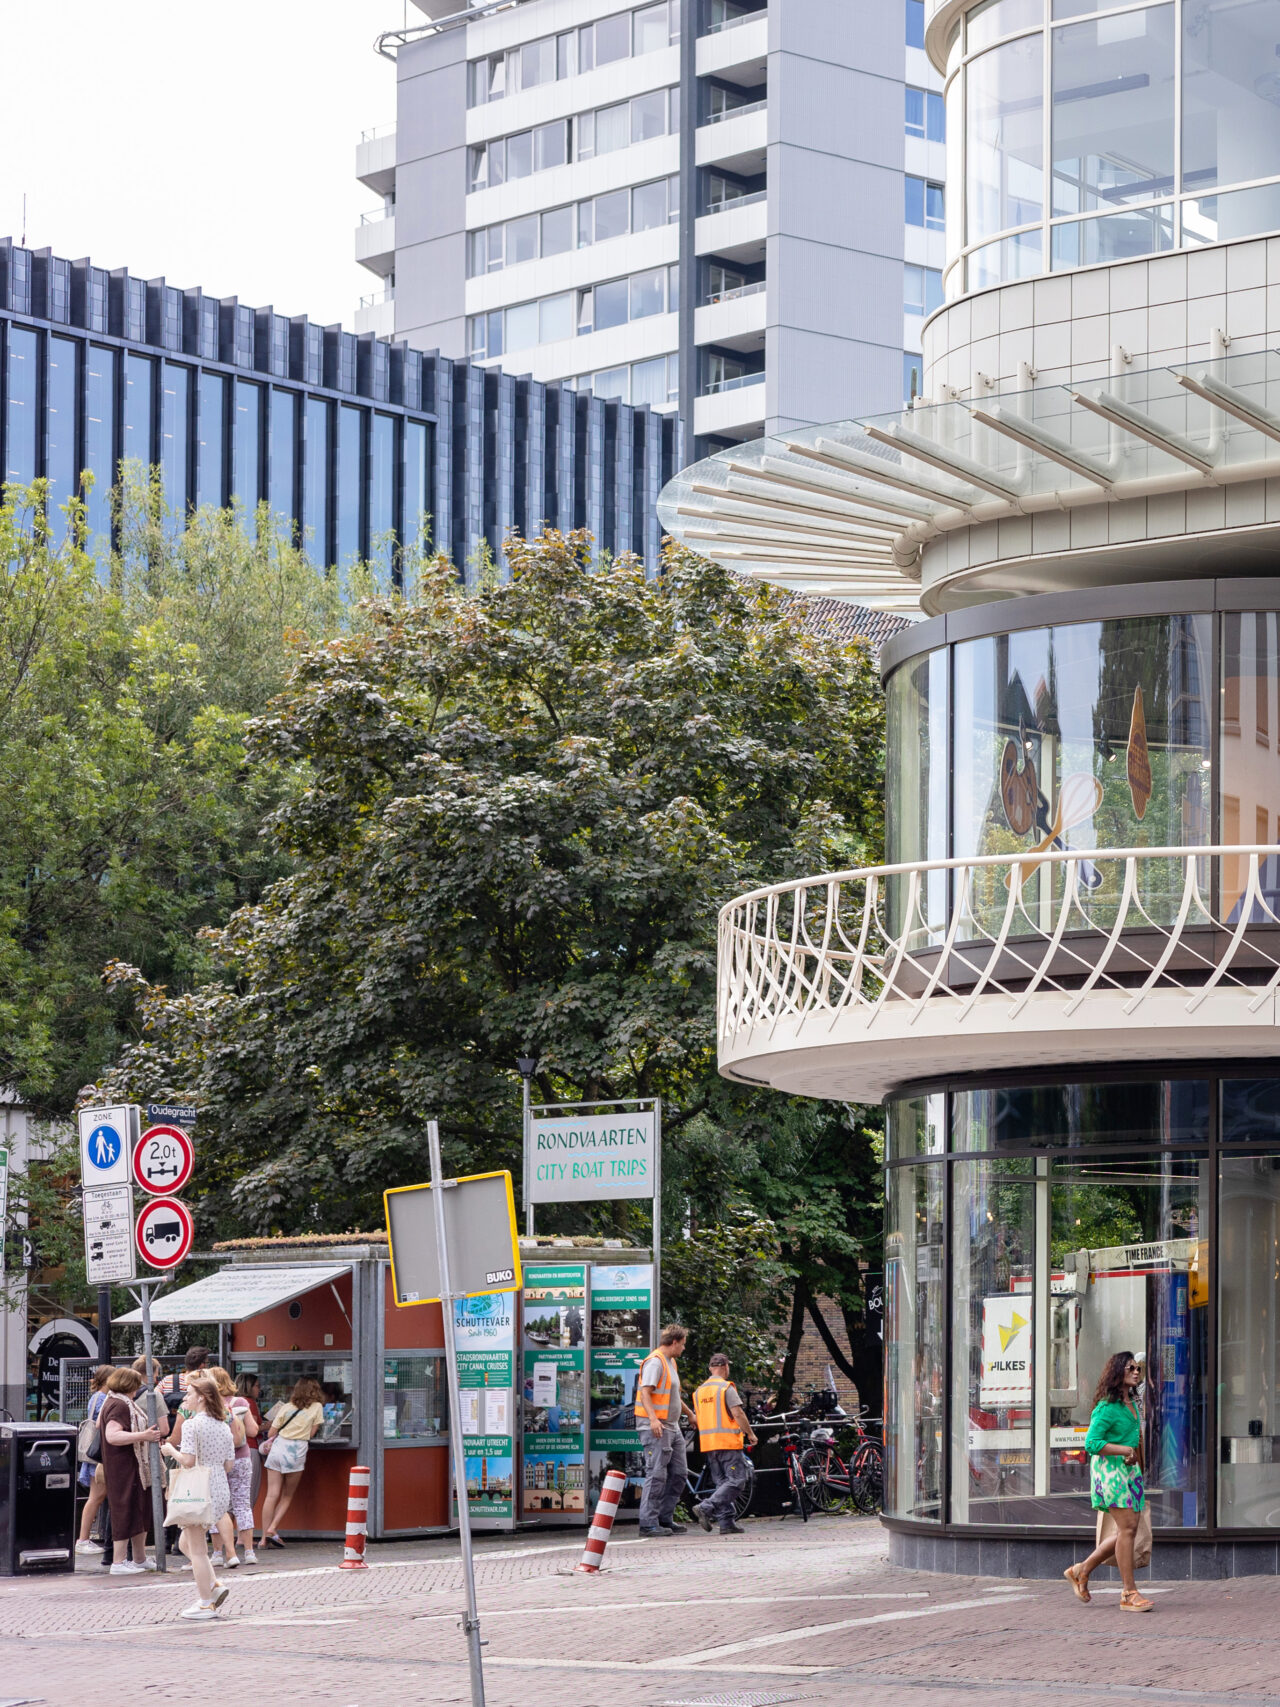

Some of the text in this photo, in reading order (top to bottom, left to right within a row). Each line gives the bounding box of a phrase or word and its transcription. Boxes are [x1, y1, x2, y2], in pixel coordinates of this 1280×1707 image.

[151, 1105, 196, 1118] Oudegracht
[93, 1113, 113, 1121] ZONE
[537, 1128, 647, 1150] RONDVAARTEN
[537, 1159, 647, 1181] CITY BOAT TRIPS
[91, 1190, 122, 1199] Toegestaan
[1125, 1249, 1140, 1264] TIME
[487, 1270, 513, 1284] BUKO
[456, 1317, 510, 1328] SCHUTTEVAER
[483, 1329, 498, 1337] 1960
[48, 1357, 59, 1367] De
[456, 1353, 509, 1361] STADSRONDVAARTEN
[487, 1362, 508, 1370] CRUISES
[988, 1360, 1026, 1371] PILKES
[485, 1448, 493, 1457] 1,5
